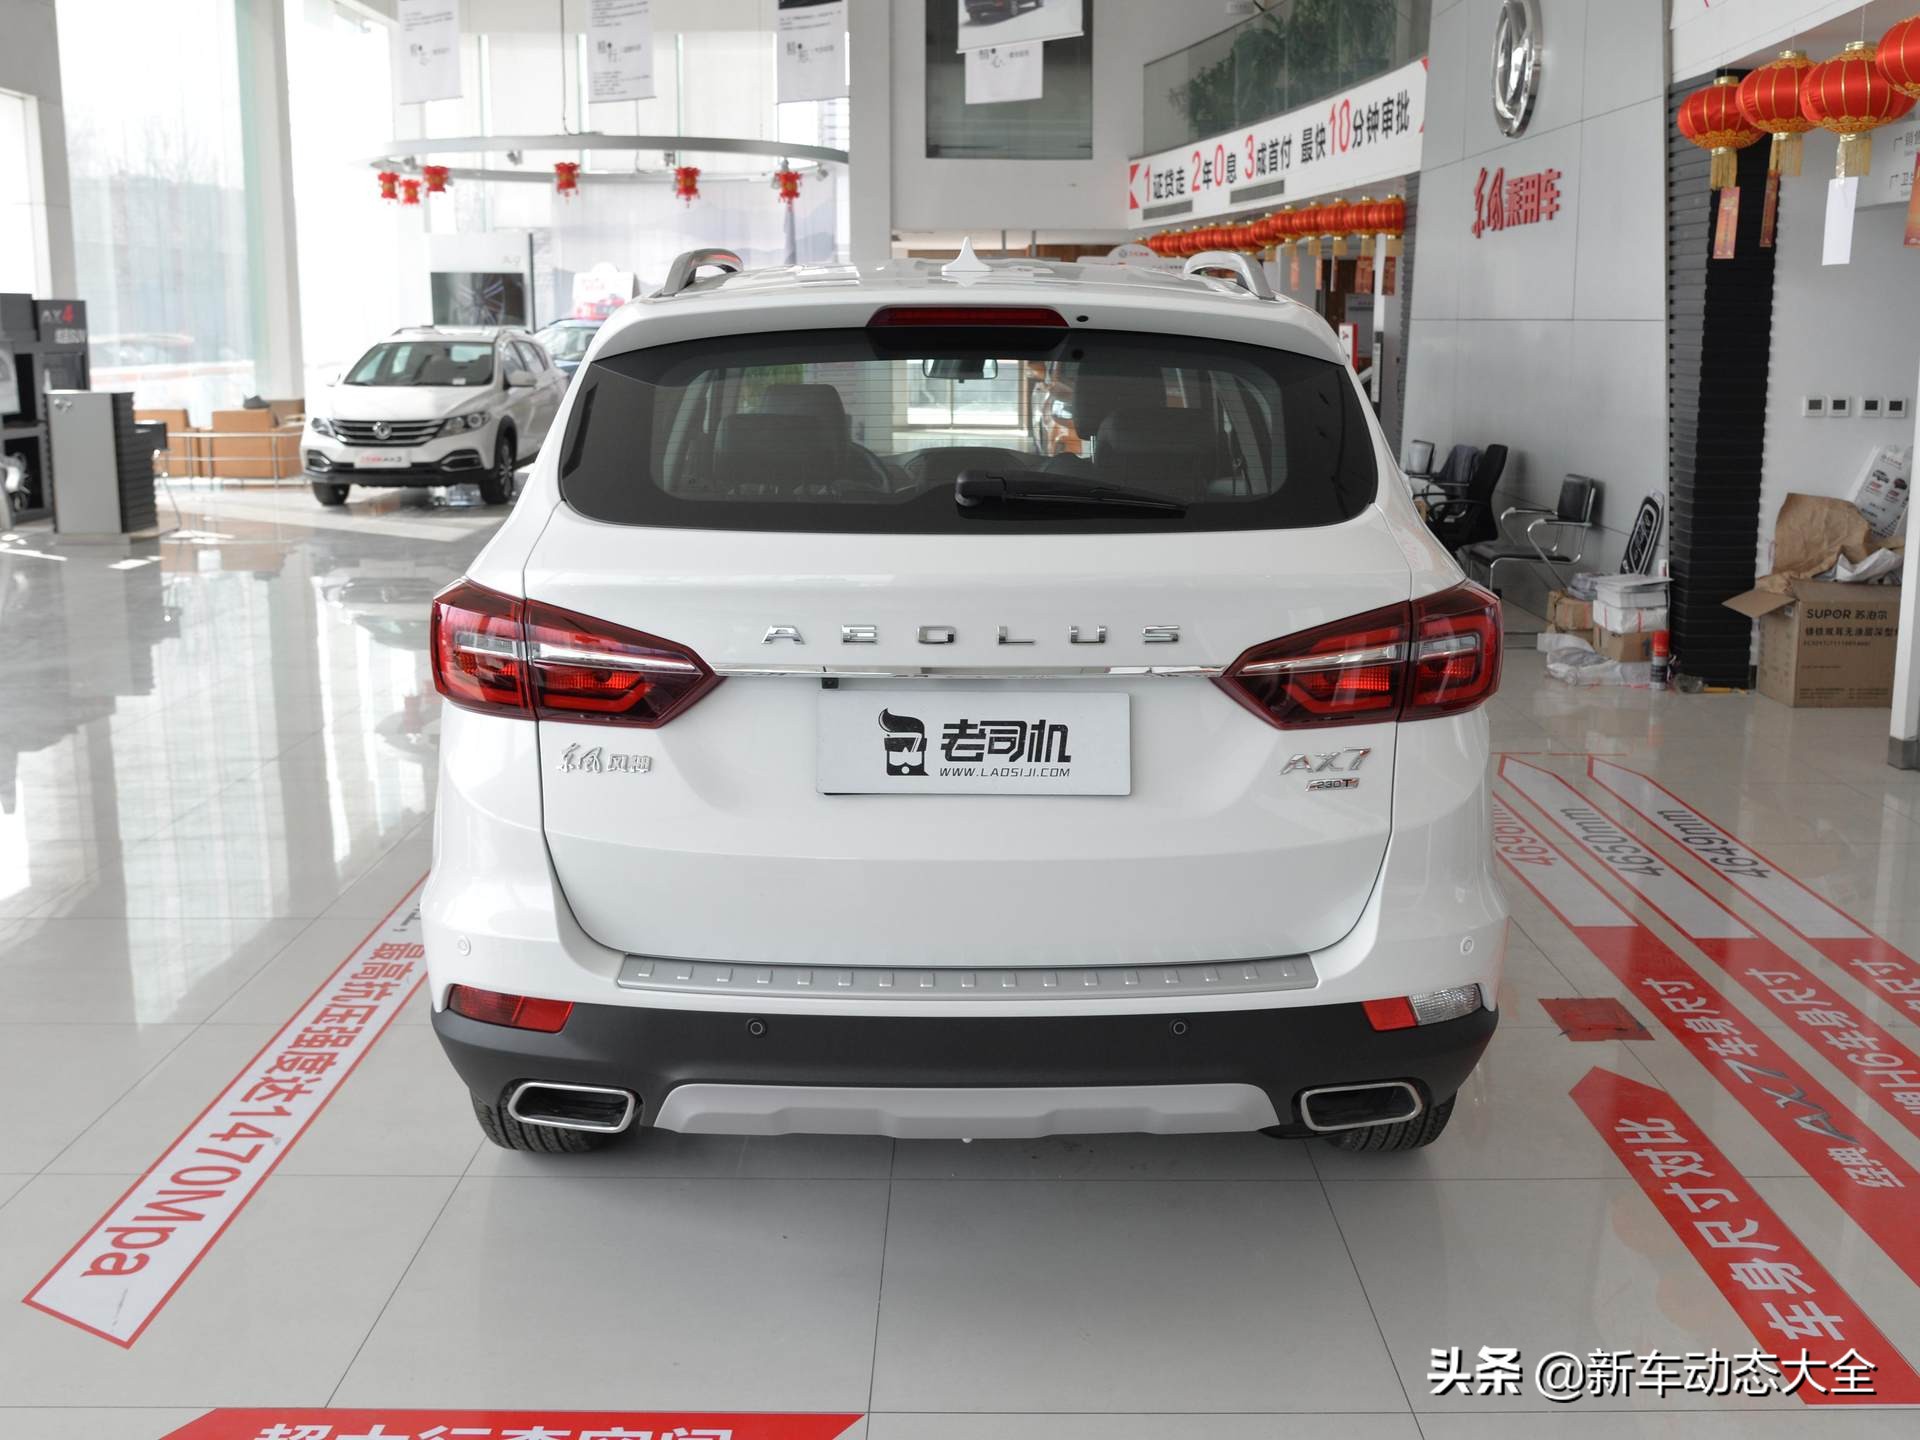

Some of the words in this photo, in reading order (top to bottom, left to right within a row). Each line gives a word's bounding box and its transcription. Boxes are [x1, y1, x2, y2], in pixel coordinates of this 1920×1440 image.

[1190, 143, 1237, 193] 2年0息
[1244, 133, 1293, 180] 3成首付
[1299, 89, 1411, 165] 最快10分钟审批
[760, 624, 1181, 645] AEOLUS
[1806, 607, 1852, 620] SUPOR
[1855, 608, 1888, 621] 苏泊尔
[940, 718, 1072, 763] 老司机
[1279, 746, 1372, 776] AX7
[938, 766, 1071, 778] WWW.LAOSIJI.COM
[1559, 807, 1665, 878] 4650mm
[1656, 809, 1769, 880] 4649mm
[1613, 1116, 1847, 1342] 车身尺寸对比
